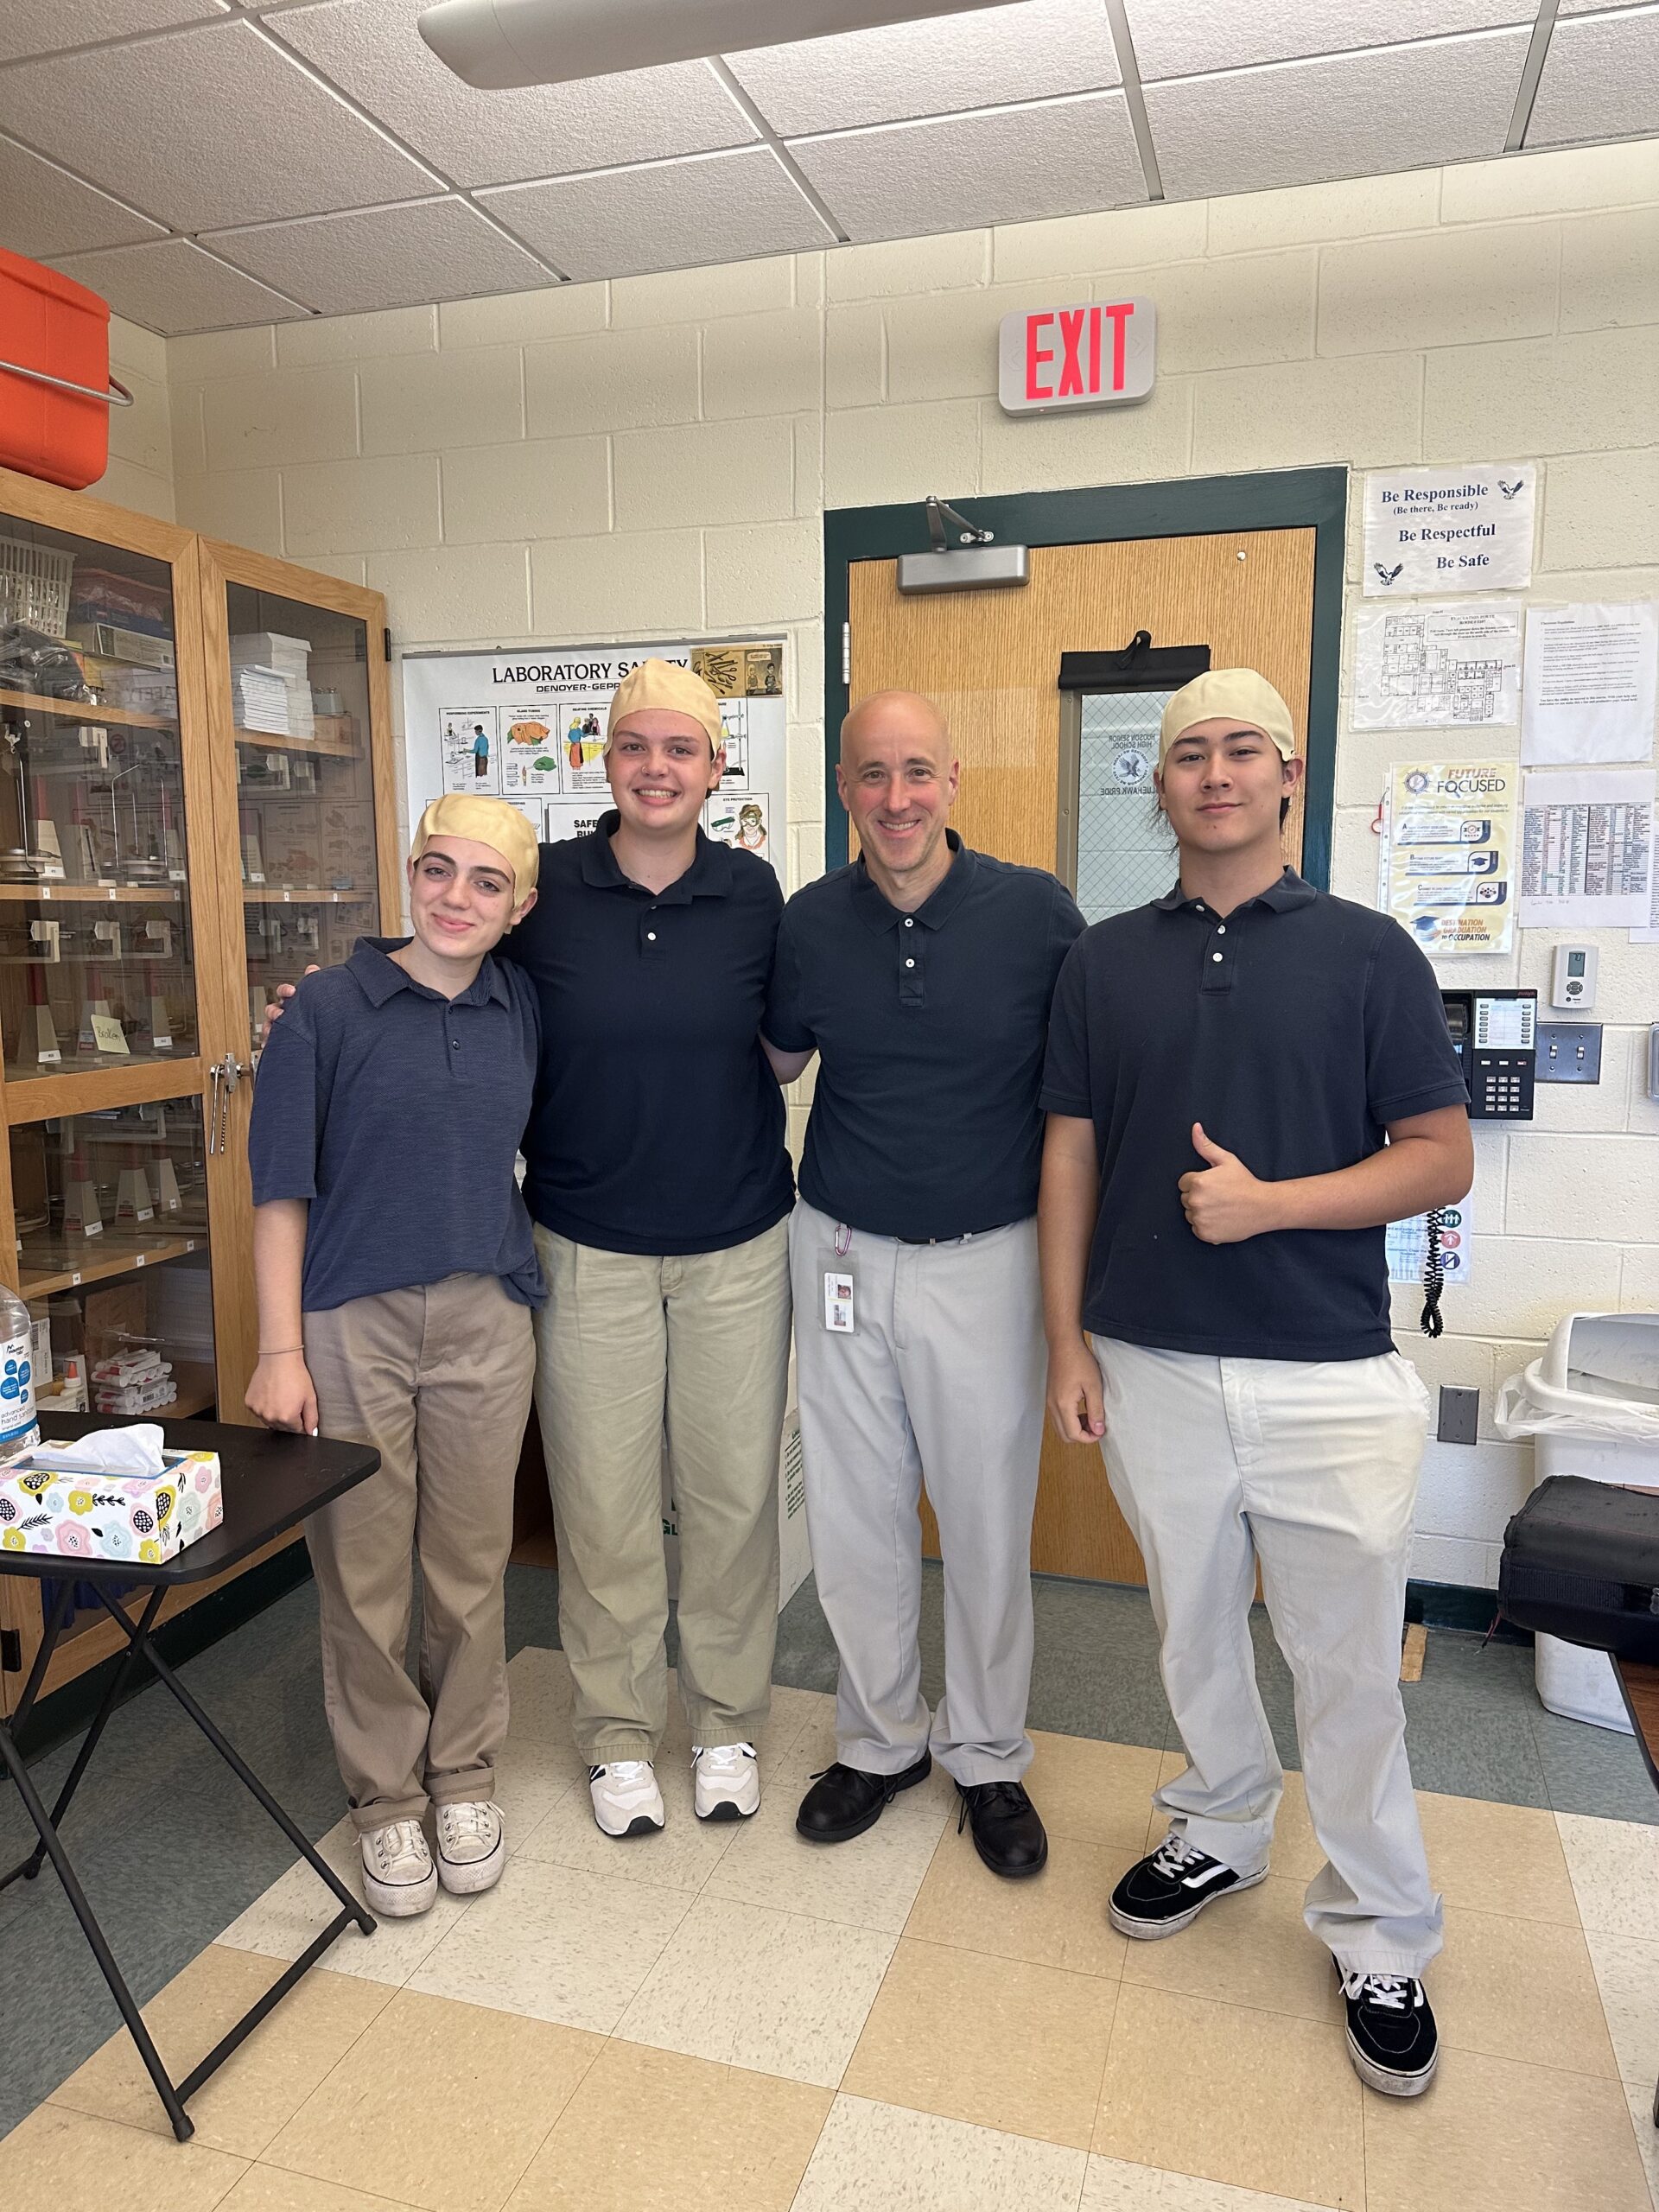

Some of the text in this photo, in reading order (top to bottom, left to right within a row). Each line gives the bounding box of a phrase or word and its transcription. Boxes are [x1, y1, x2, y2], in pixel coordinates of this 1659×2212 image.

[1026, 302, 1135, 400] EXIT
[1382, 484, 1489, 503] Be Responsible
[1393, 506, 1408, 516] (Be
[1437, 503, 1448, 512] Be
[1451, 501, 1478, 512] ready)
[1399, 524, 1496, 542] Be Respectful
[1436, 554, 1491, 569] Be Safe
[492, 663, 613, 683] LABORATORY
[536, 682, 620, 693] DENOYER-GEPP
[1448, 767, 1497, 779] FUTURE
[1437, 779, 1506, 793] FOCUSED
[574, 819, 598, 828] SAFE
[95, 1026, 121, 1042] Broken
[1, 1415, 18, 1426] hand
